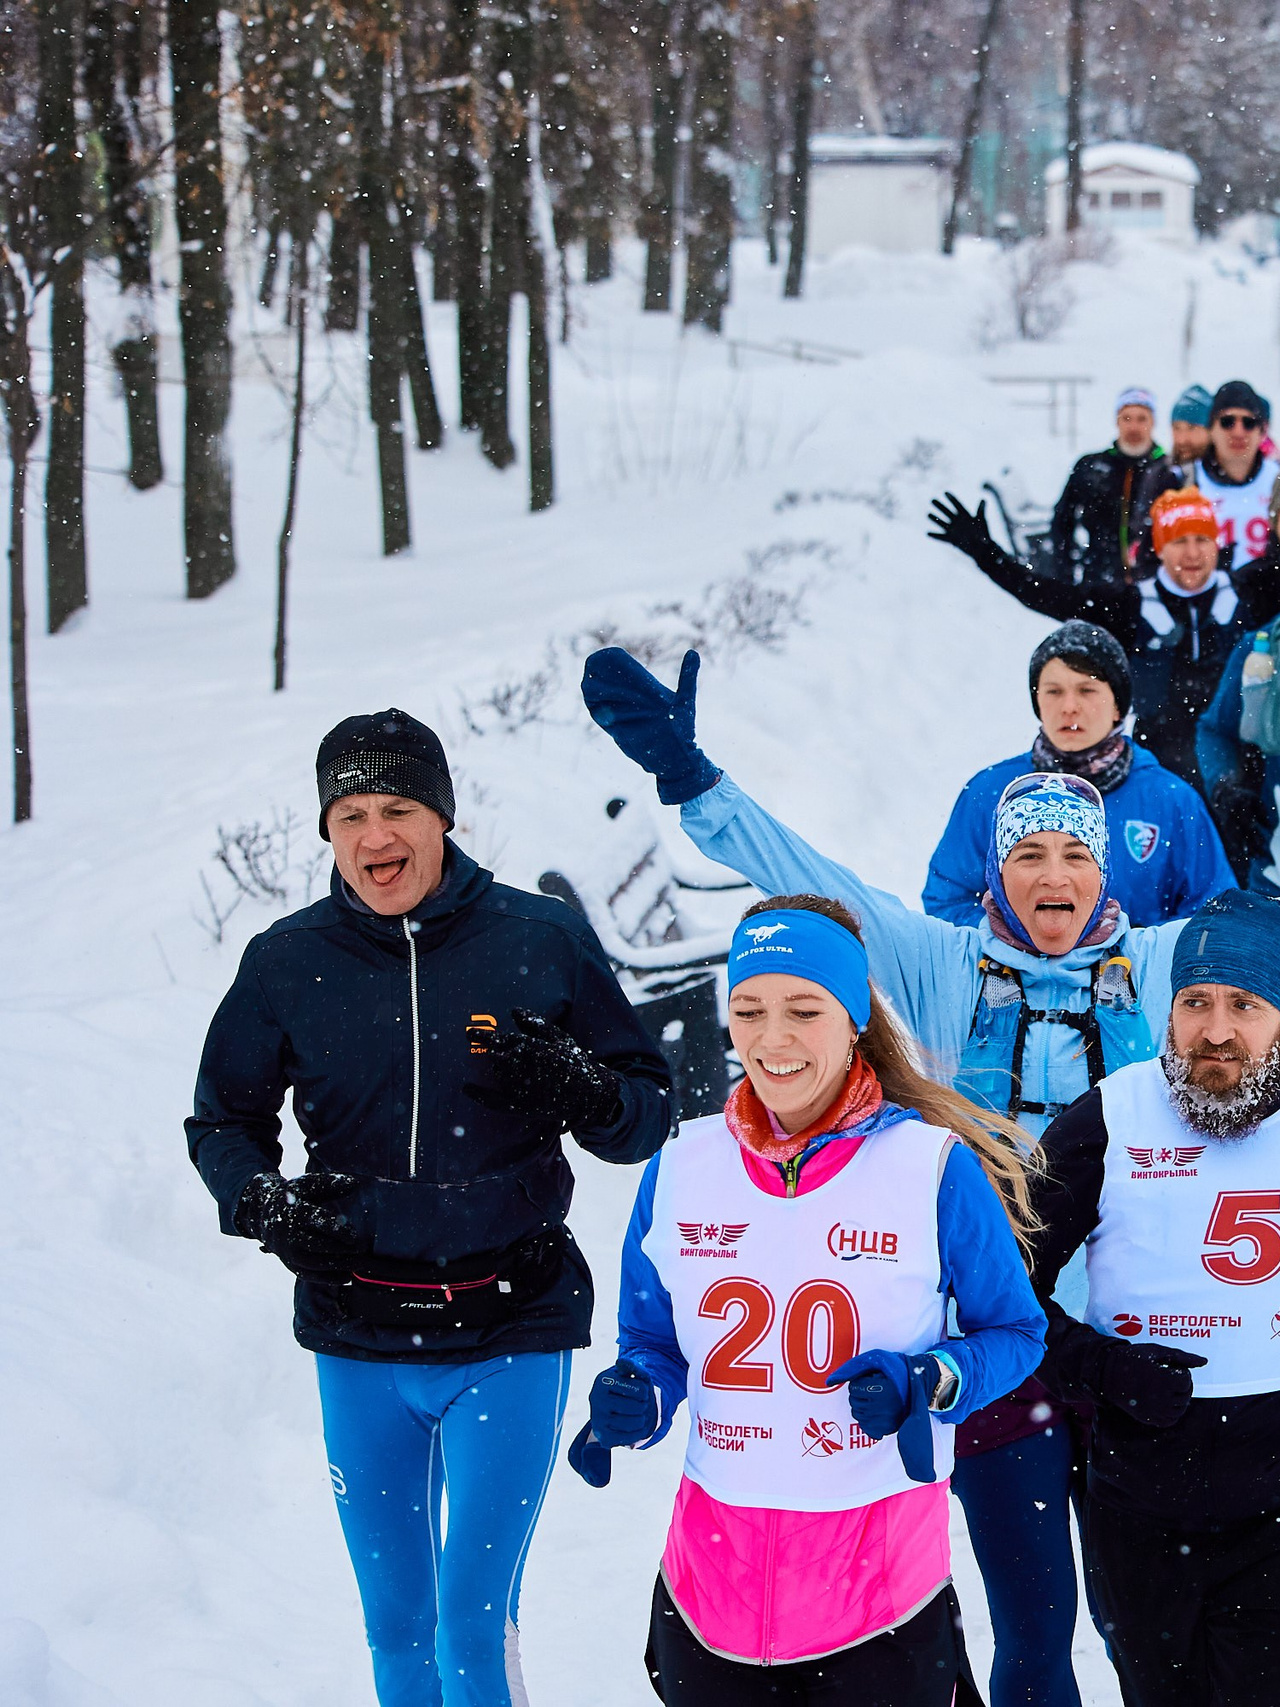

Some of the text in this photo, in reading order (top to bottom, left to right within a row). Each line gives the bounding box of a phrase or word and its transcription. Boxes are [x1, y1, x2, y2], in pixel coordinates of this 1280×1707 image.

[736, 946, 793, 961] MAD FOX ULTRA
[1131, 1168, 1199, 1179] ВИНТОКРЫЛЫЕ
[839, 1229, 898, 1255] НЦВ
[680, 1248, 738, 1259] ВИНТОКРЫЛЫЕ
[1148, 1315, 1242, 1327] ВЕРТОЛЕТЫ
[697, 1276, 861, 1395] 20
[1149, 1327, 1211, 1338] РОССИИ
[703, 1418, 772, 1440] ВЕРТОЛЕТЫ
